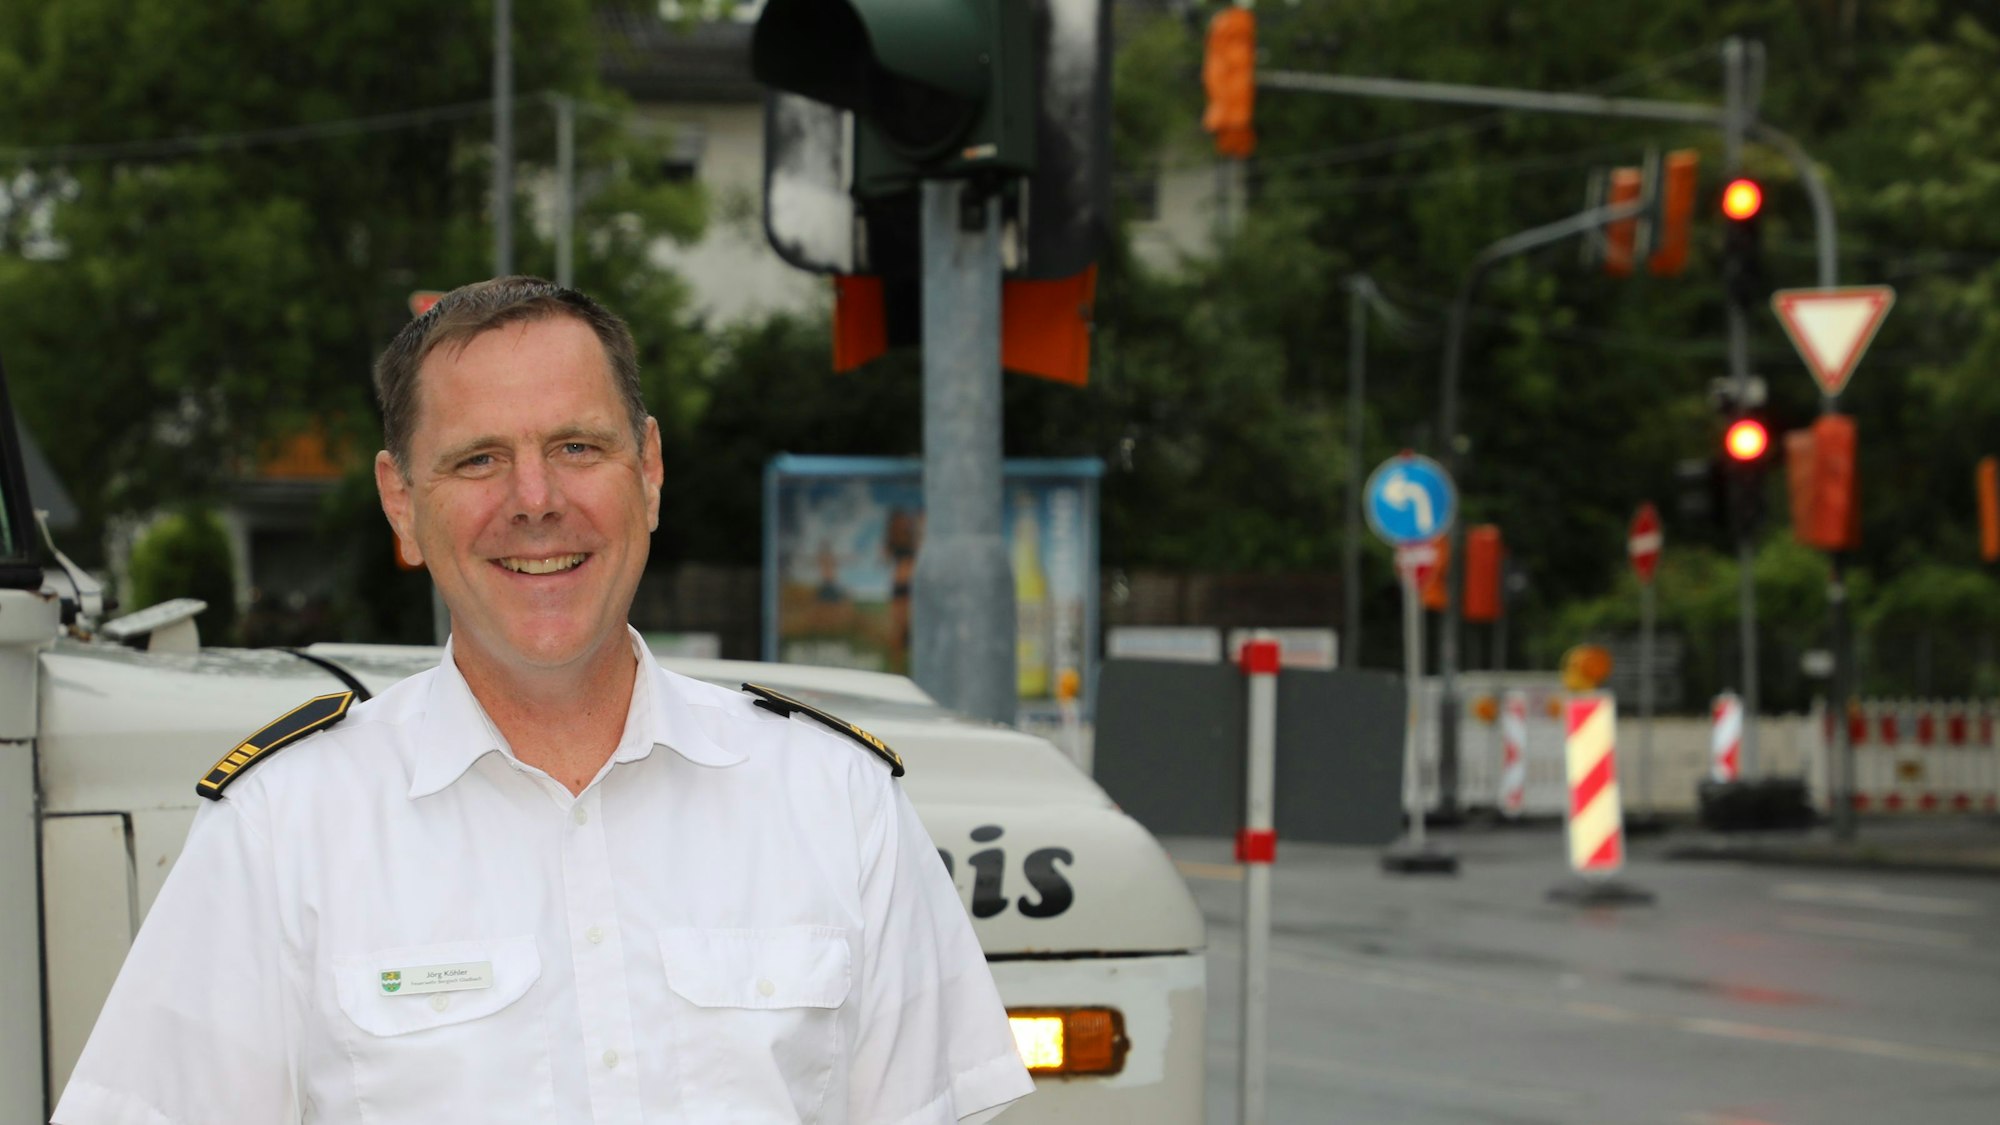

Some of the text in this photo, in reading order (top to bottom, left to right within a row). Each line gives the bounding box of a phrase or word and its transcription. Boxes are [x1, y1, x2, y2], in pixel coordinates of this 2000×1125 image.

[937, 824, 1075, 919] is
[426, 968, 468, 979] Jörg Köhler
